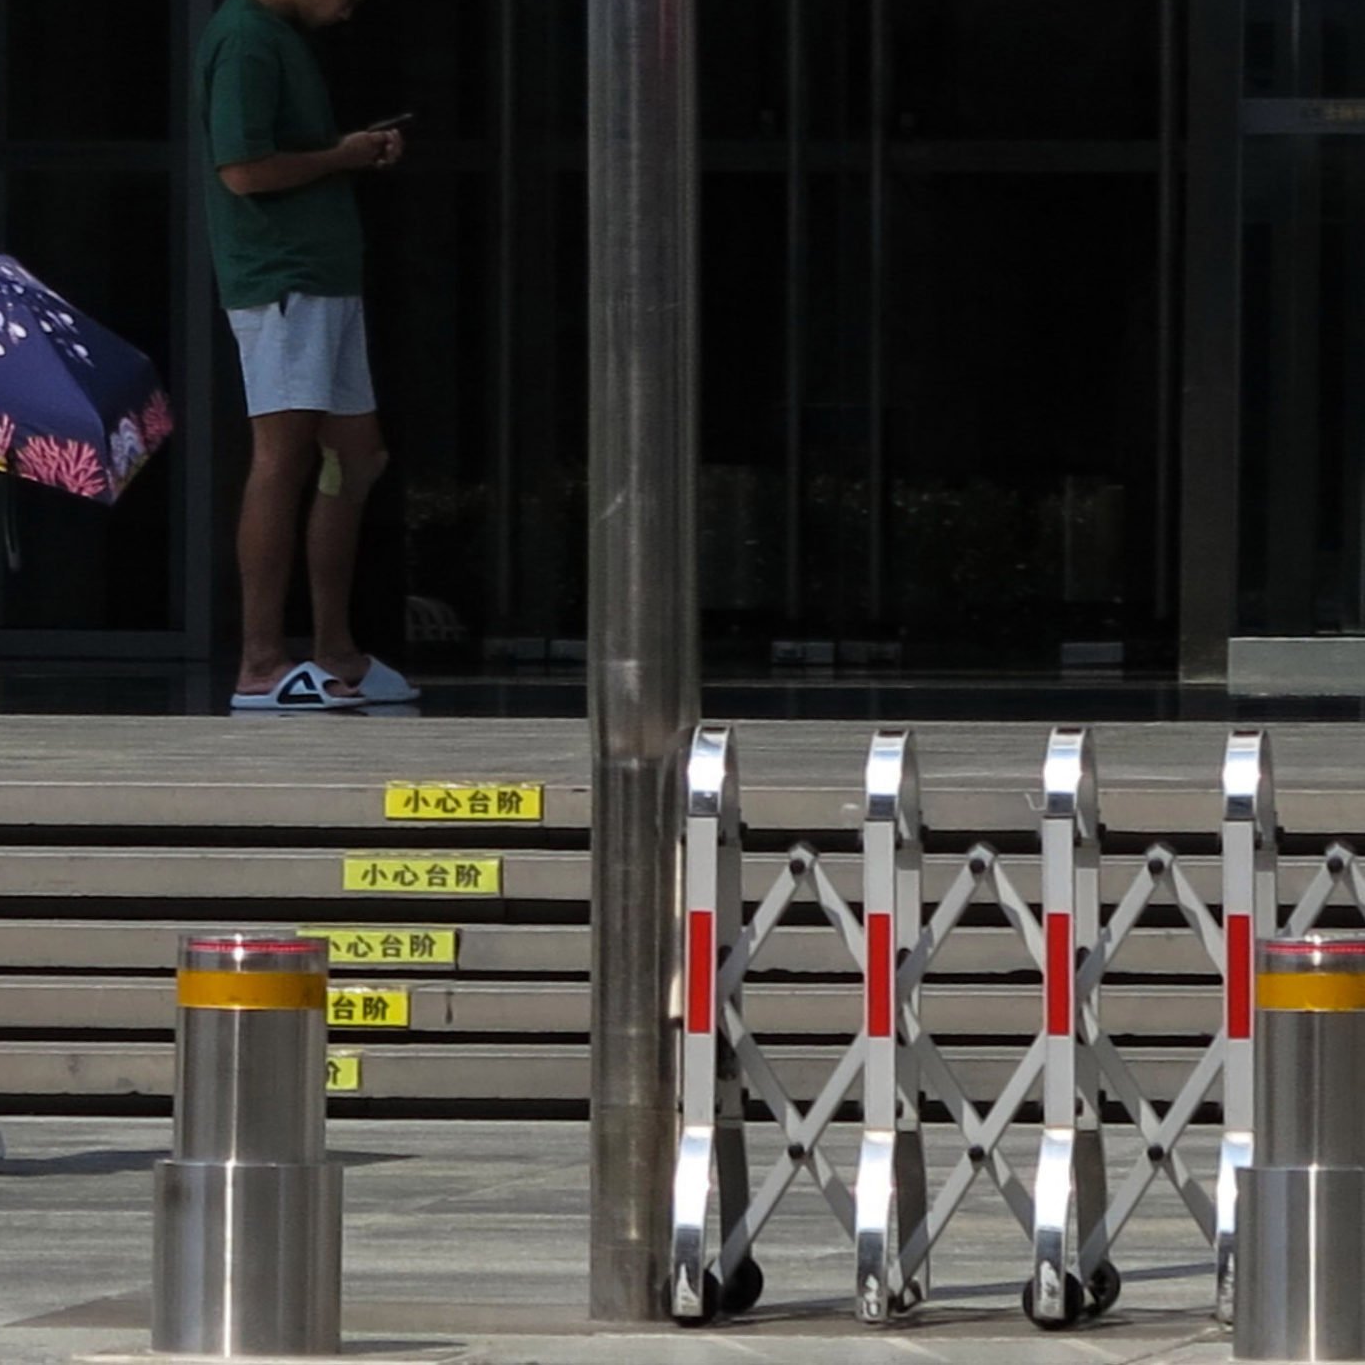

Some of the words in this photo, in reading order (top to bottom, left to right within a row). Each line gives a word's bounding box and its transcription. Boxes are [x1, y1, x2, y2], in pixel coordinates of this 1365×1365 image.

[404, 790, 523, 814] 小心台阶
[361, 863, 481, 888] 小心台阶
